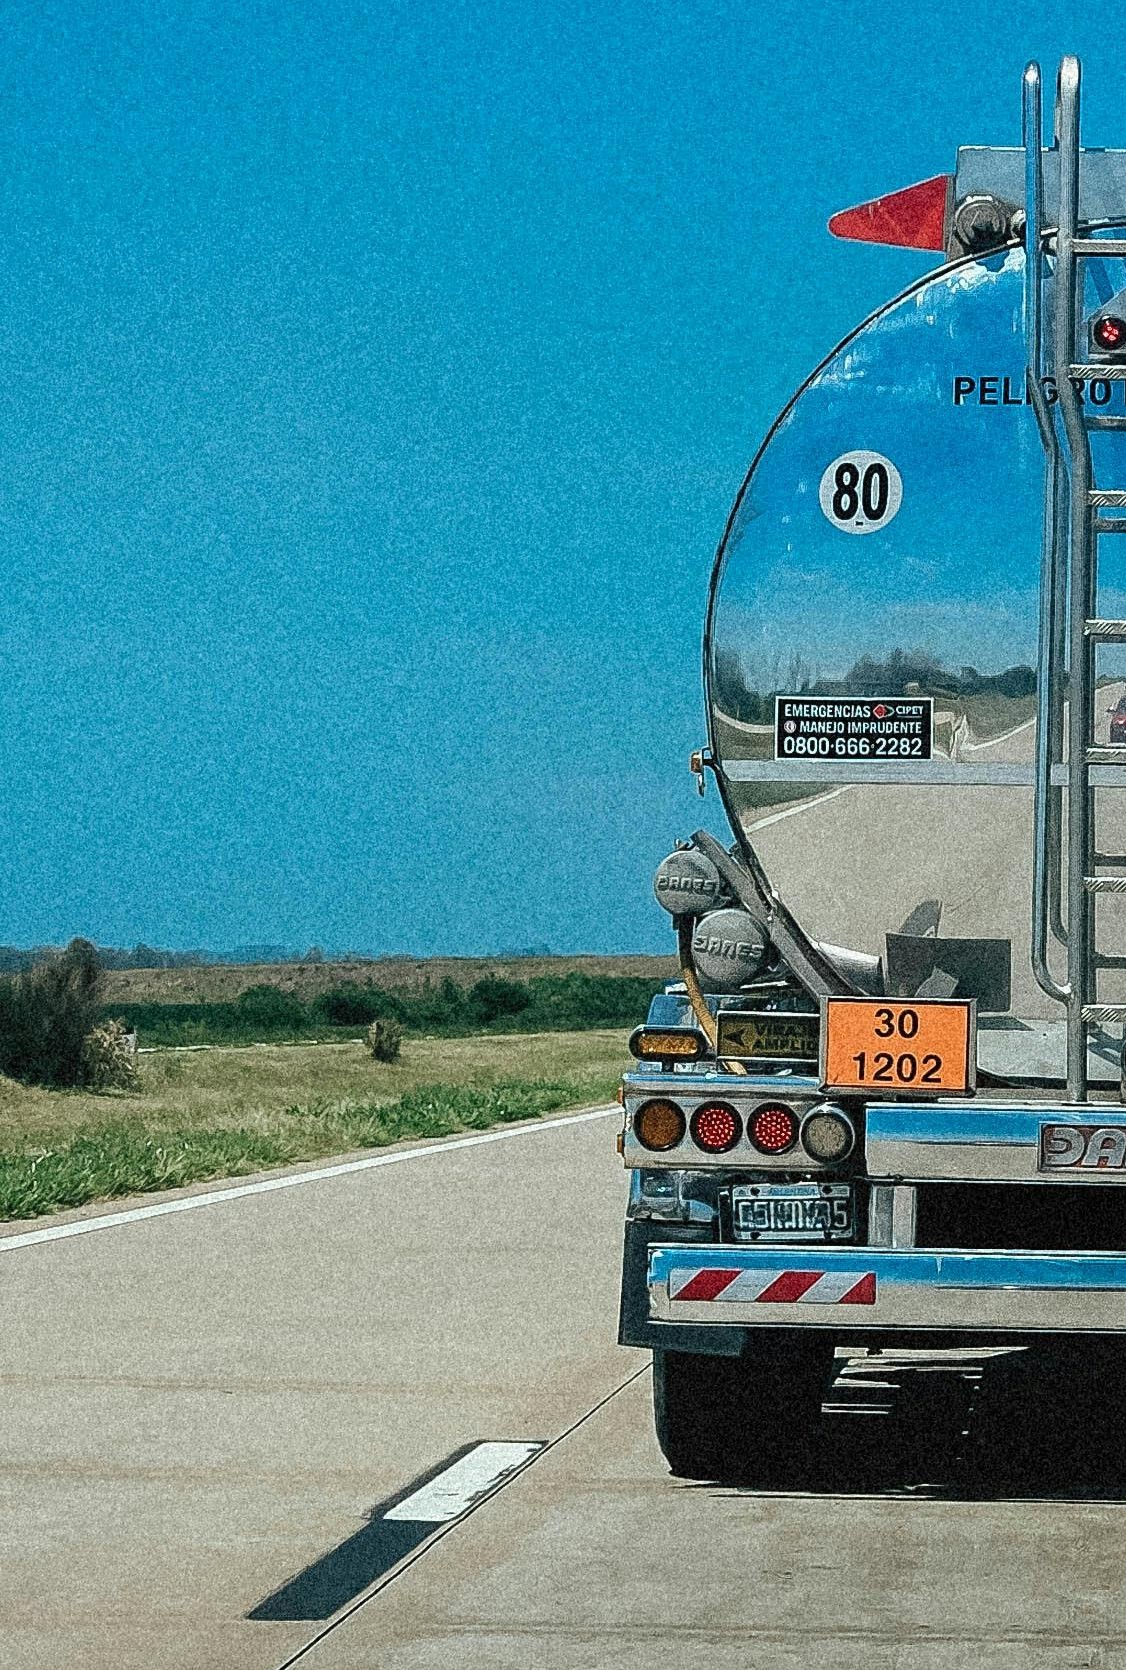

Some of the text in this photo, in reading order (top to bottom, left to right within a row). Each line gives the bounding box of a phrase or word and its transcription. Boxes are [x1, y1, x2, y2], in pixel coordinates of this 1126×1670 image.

[953, 375, 1112, 406] PELIGRO
[832, 462, 889, 521] 80
[784, 703, 871, 718] EMERGENCIAS
[800, 720, 922, 734] MANEJO IMPRUDENTE
[874, 1008, 919, 1039] 30
[852, 1051, 943, 1083] 1202
